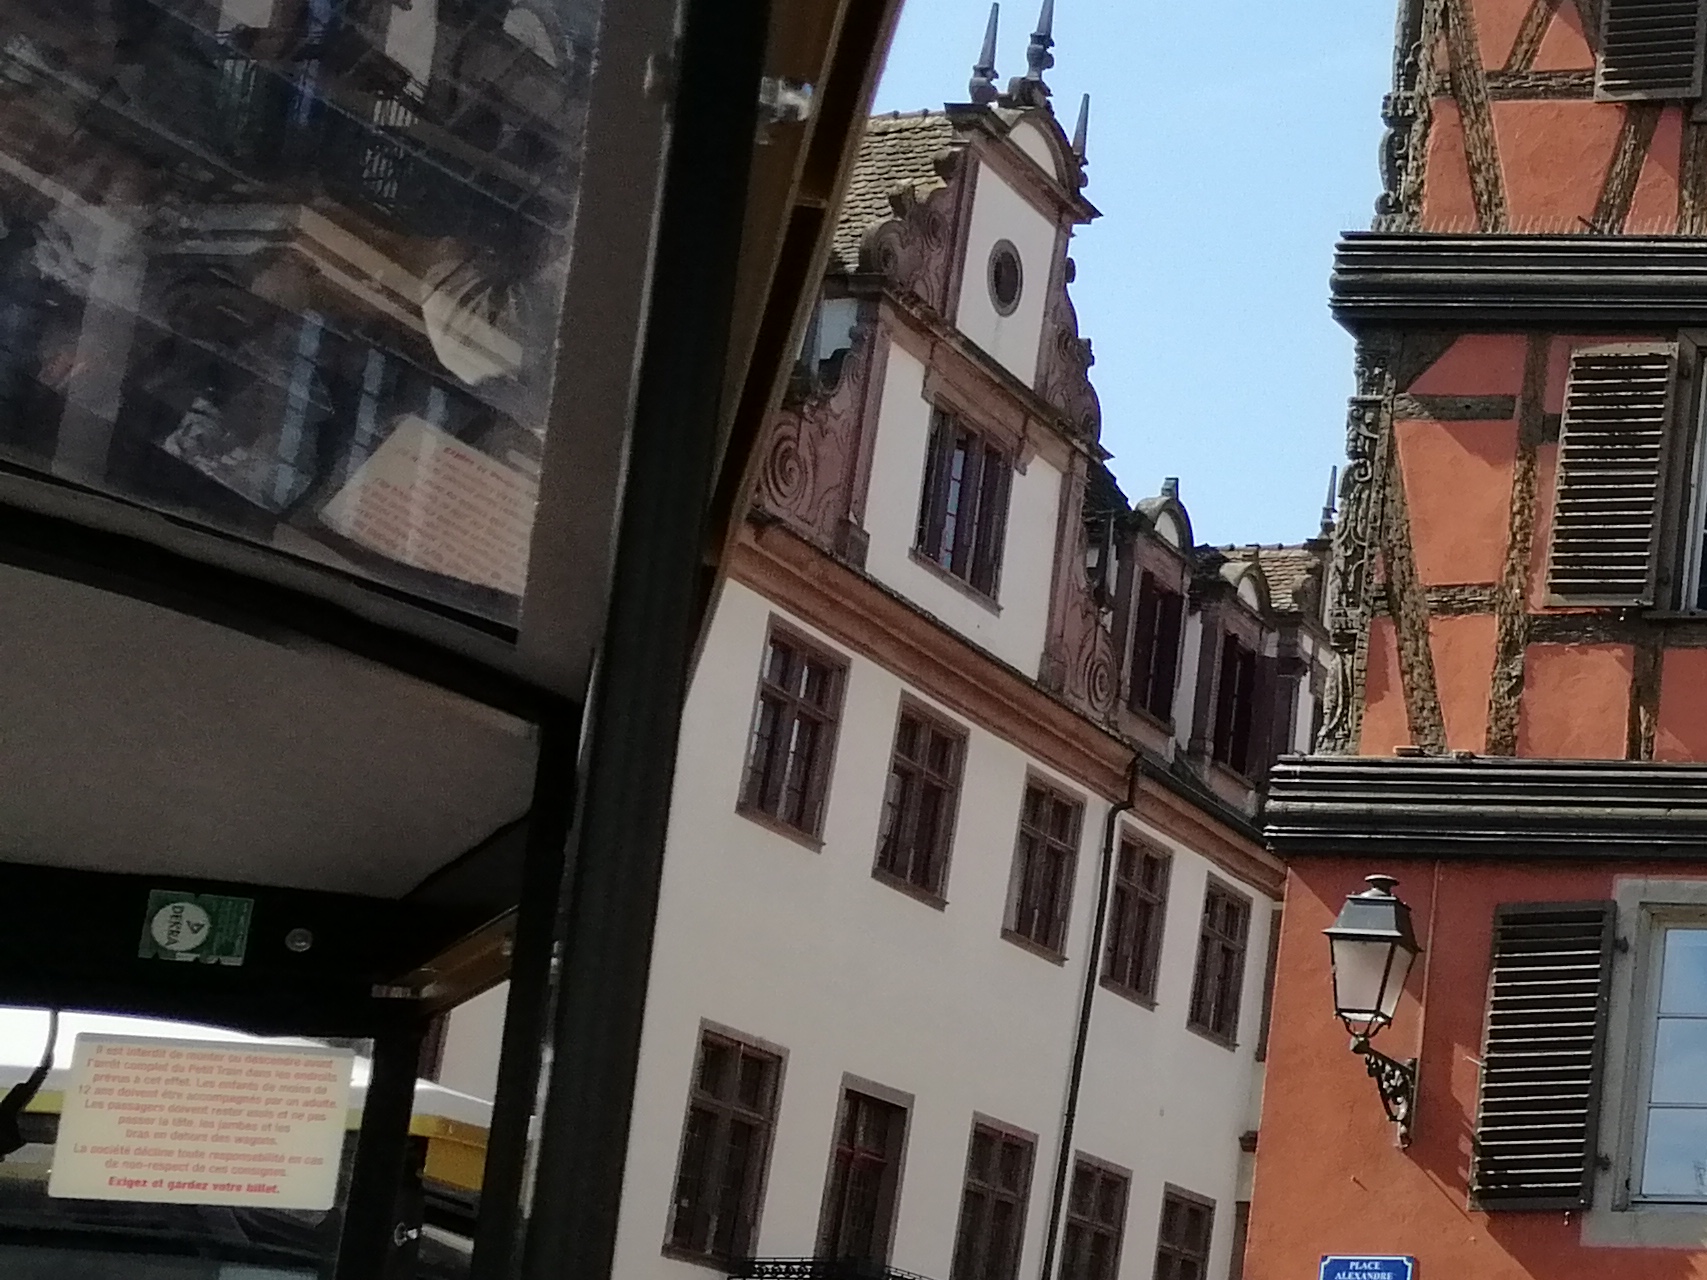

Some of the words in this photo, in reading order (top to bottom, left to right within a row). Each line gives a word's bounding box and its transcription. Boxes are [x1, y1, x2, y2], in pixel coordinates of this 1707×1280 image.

[165, 905, 185, 946] DEKRA
[108, 1176, 147, 1189] Exigez
[168, 1179, 208, 1191] gardez
[1349, 1261, 1381, 1271] PLACE
[1334, 1271, 1394, 1280] ALEXANDRE
